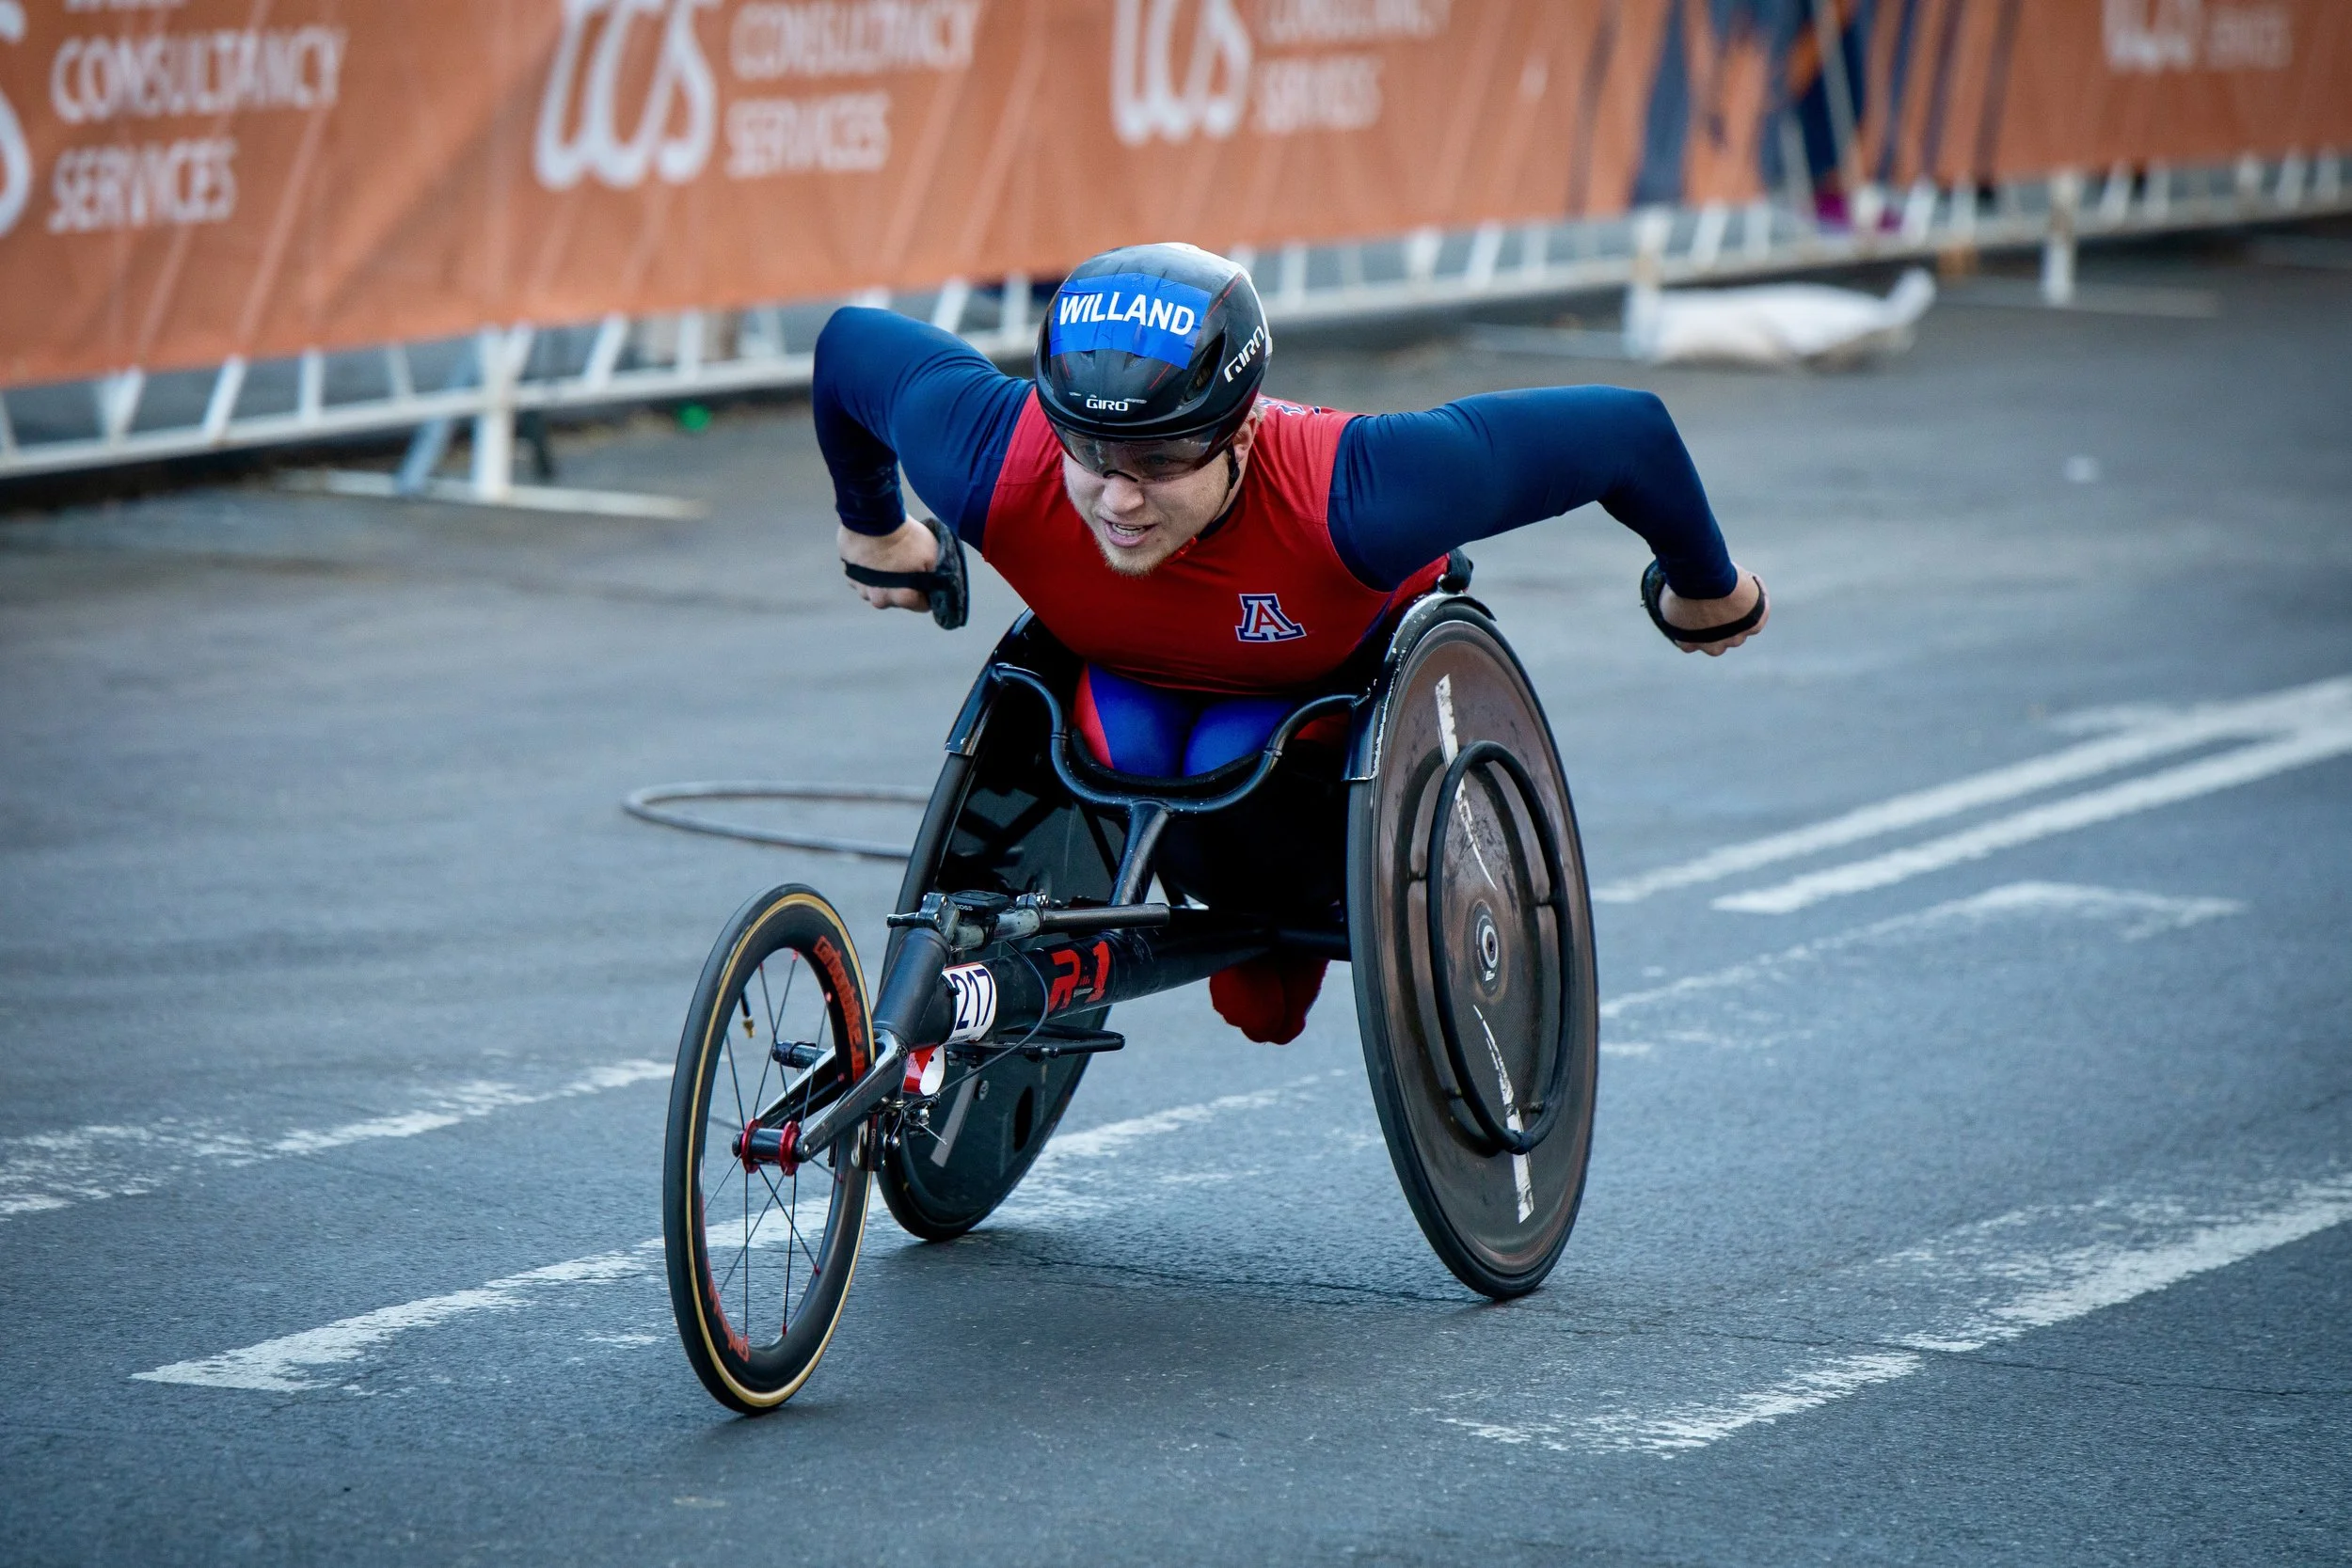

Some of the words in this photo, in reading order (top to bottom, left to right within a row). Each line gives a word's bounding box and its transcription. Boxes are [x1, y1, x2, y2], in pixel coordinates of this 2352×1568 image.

[51, 24, 349, 124] CONSULTANCY
[48, 137, 238, 234] SERVICES
[1059, 292, 1195, 336] WILLAND
[1224, 325, 1265, 384] GIRO
[1086, 398, 1129, 412] GIRO
[1234, 594, 1307, 642] A
[951, 968, 993, 1031] 217
